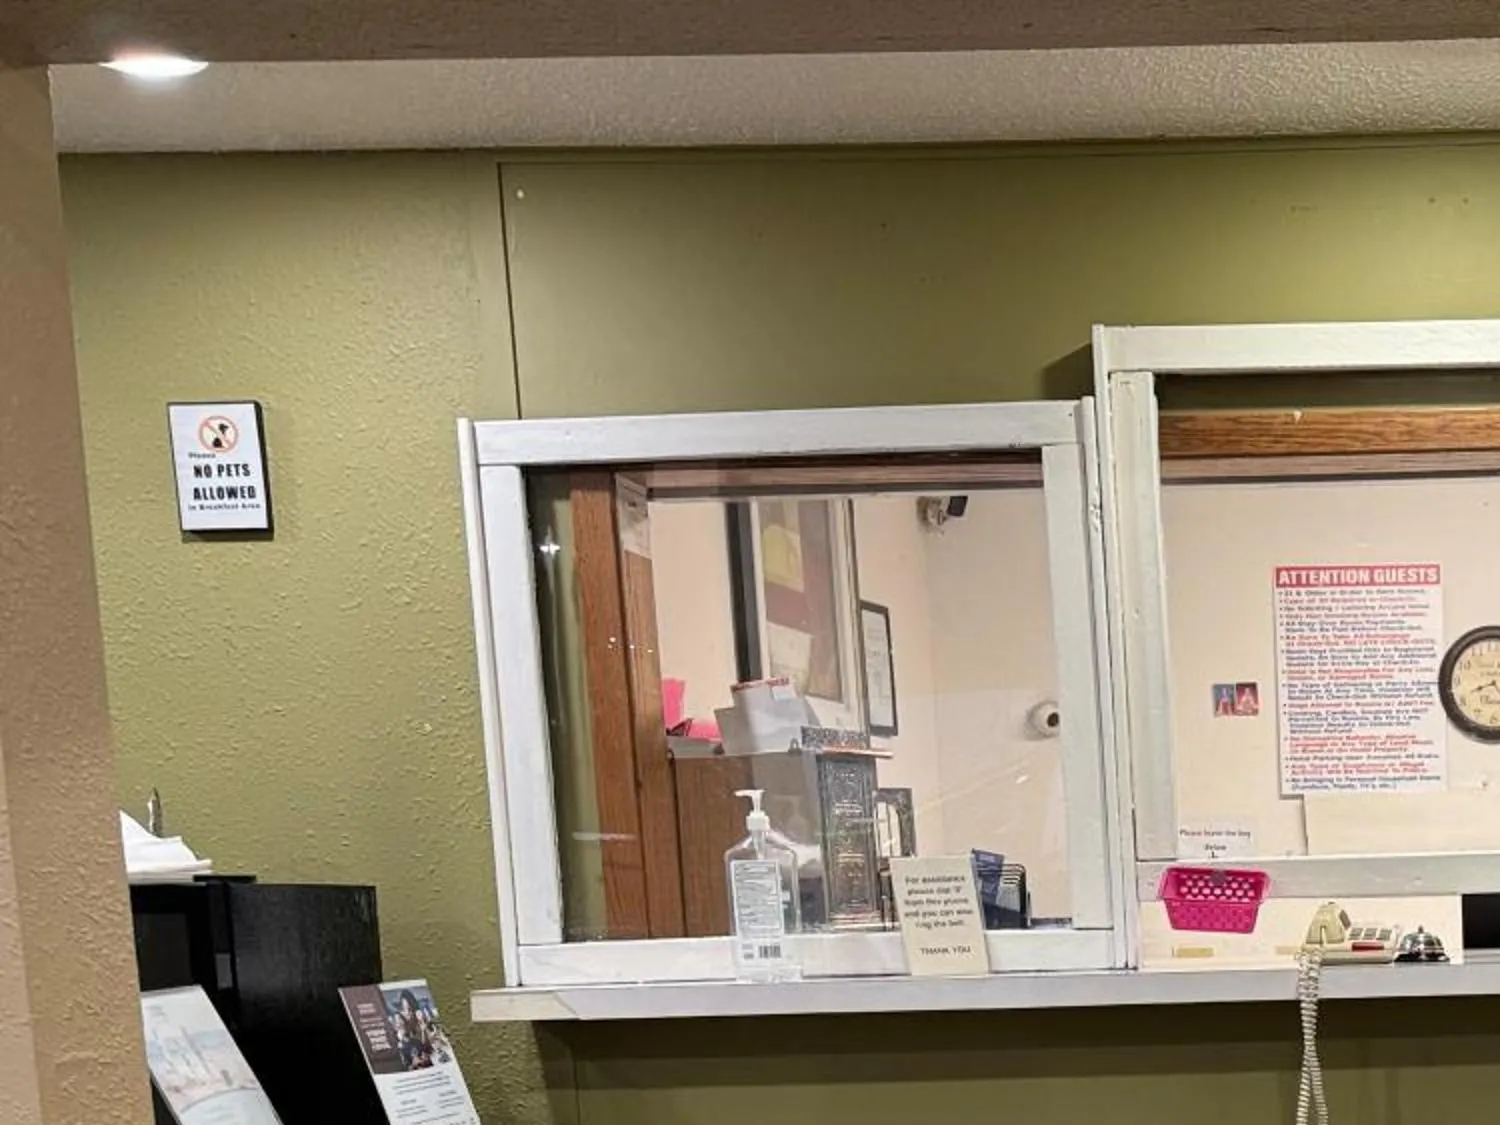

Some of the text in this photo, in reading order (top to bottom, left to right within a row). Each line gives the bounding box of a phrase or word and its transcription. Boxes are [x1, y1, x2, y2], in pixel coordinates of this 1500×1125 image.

[194, 464, 250, 478] NO PETS
[193, 486, 256, 500] ALLOWED
[1279, 567, 1438, 585] ATTENTION GUESTS
[920, 947, 950, 955] THANK
